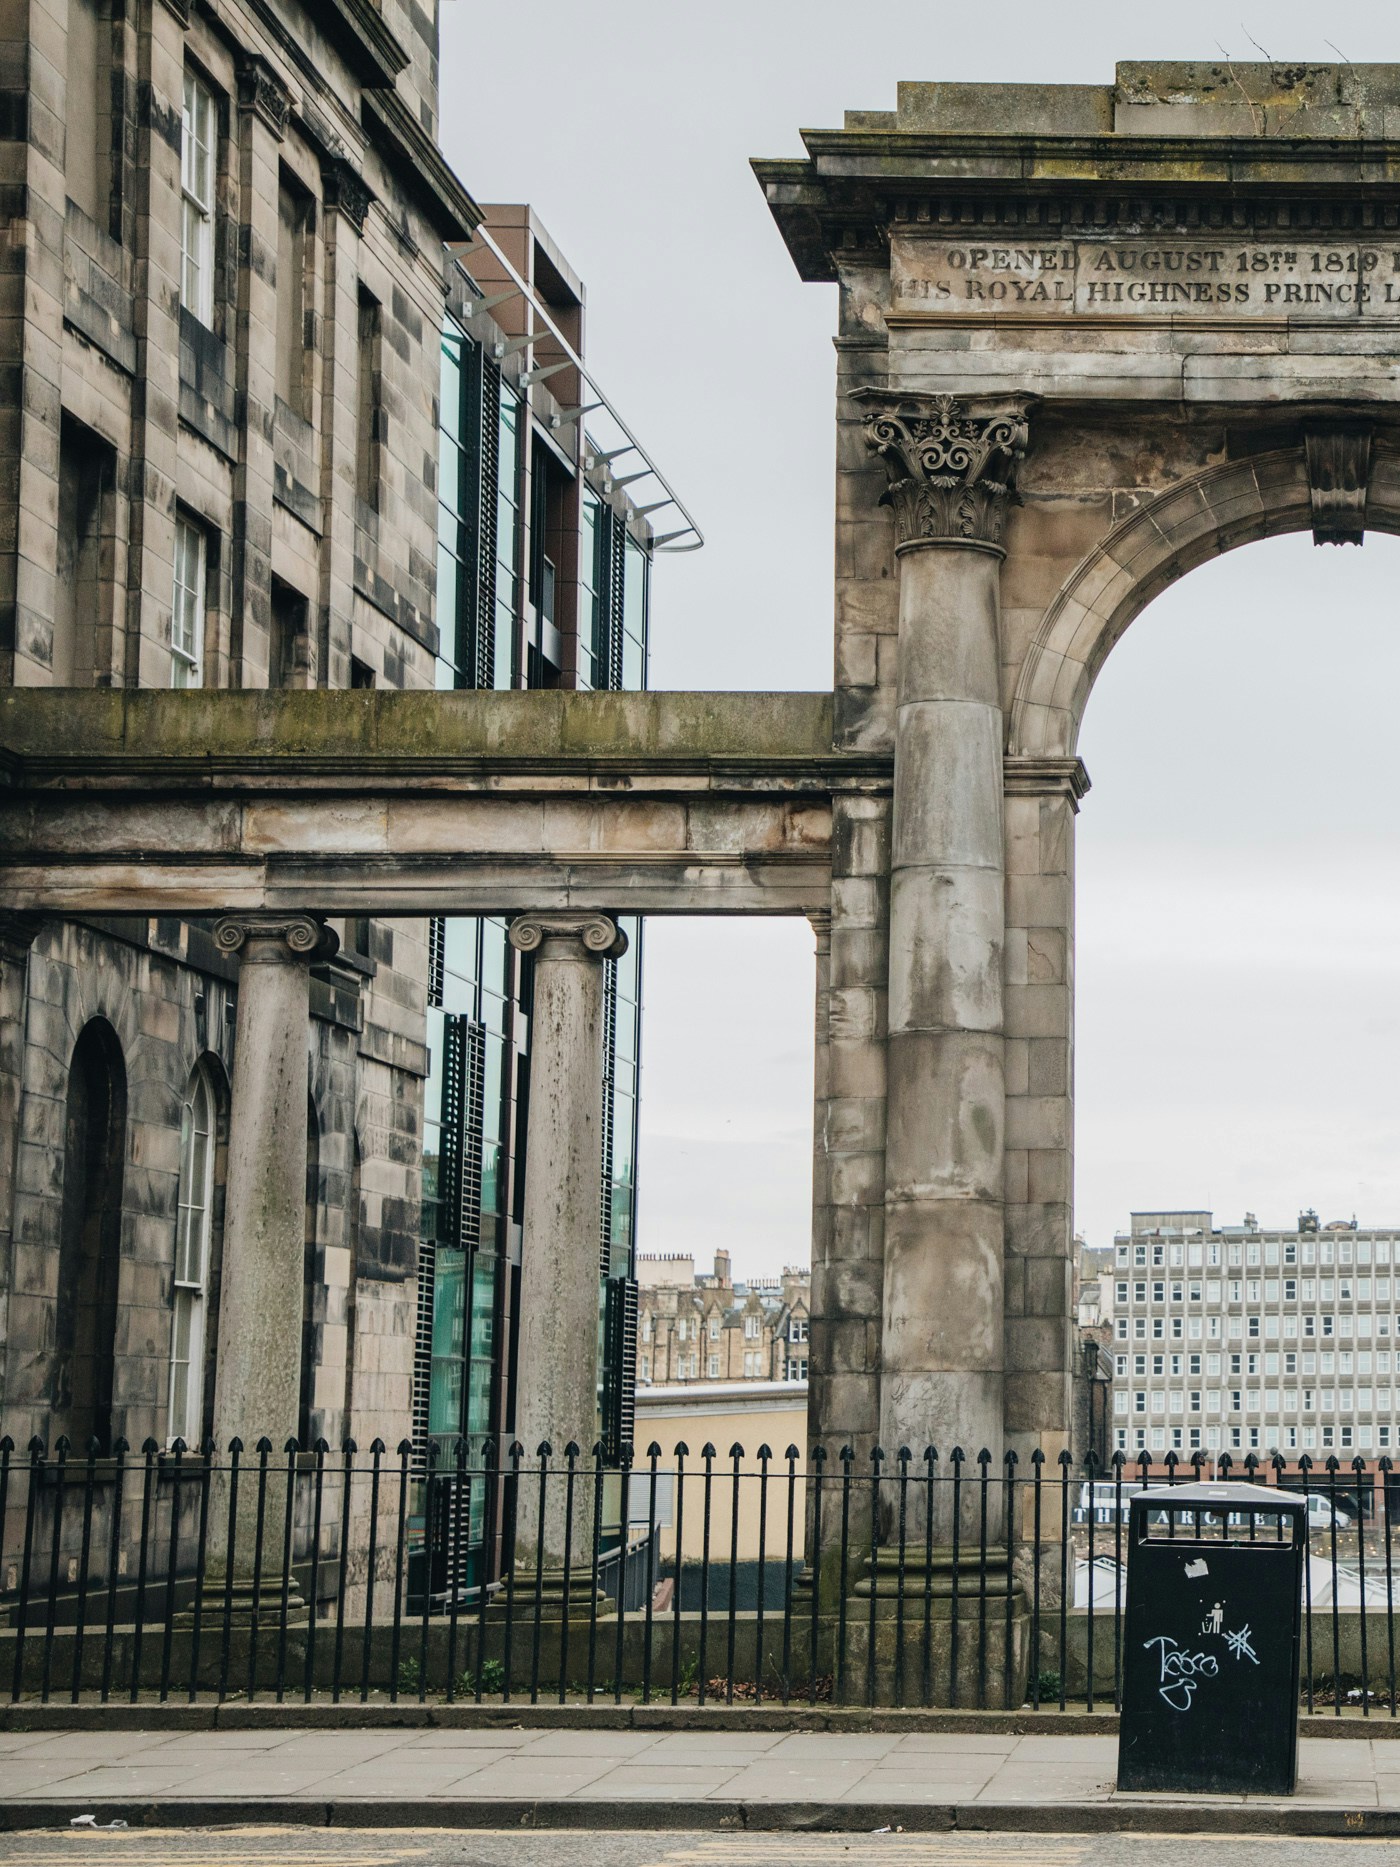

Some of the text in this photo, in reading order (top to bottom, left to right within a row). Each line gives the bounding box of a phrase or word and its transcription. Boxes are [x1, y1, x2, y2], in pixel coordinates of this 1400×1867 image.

[947, 249, 1079, 271] OPENED
[1094, 251, 1224, 272] AUGUST
[1310, 252, 1379, 272] 1819
[897, 279, 950, 299] HIS
[965, 280, 1073, 301] ROYAL
[1088, 282, 1250, 302] HIGHNESS
[1264, 283, 1371, 303] PRINCE
[1156, 1510, 1287, 1525] ARCHES
